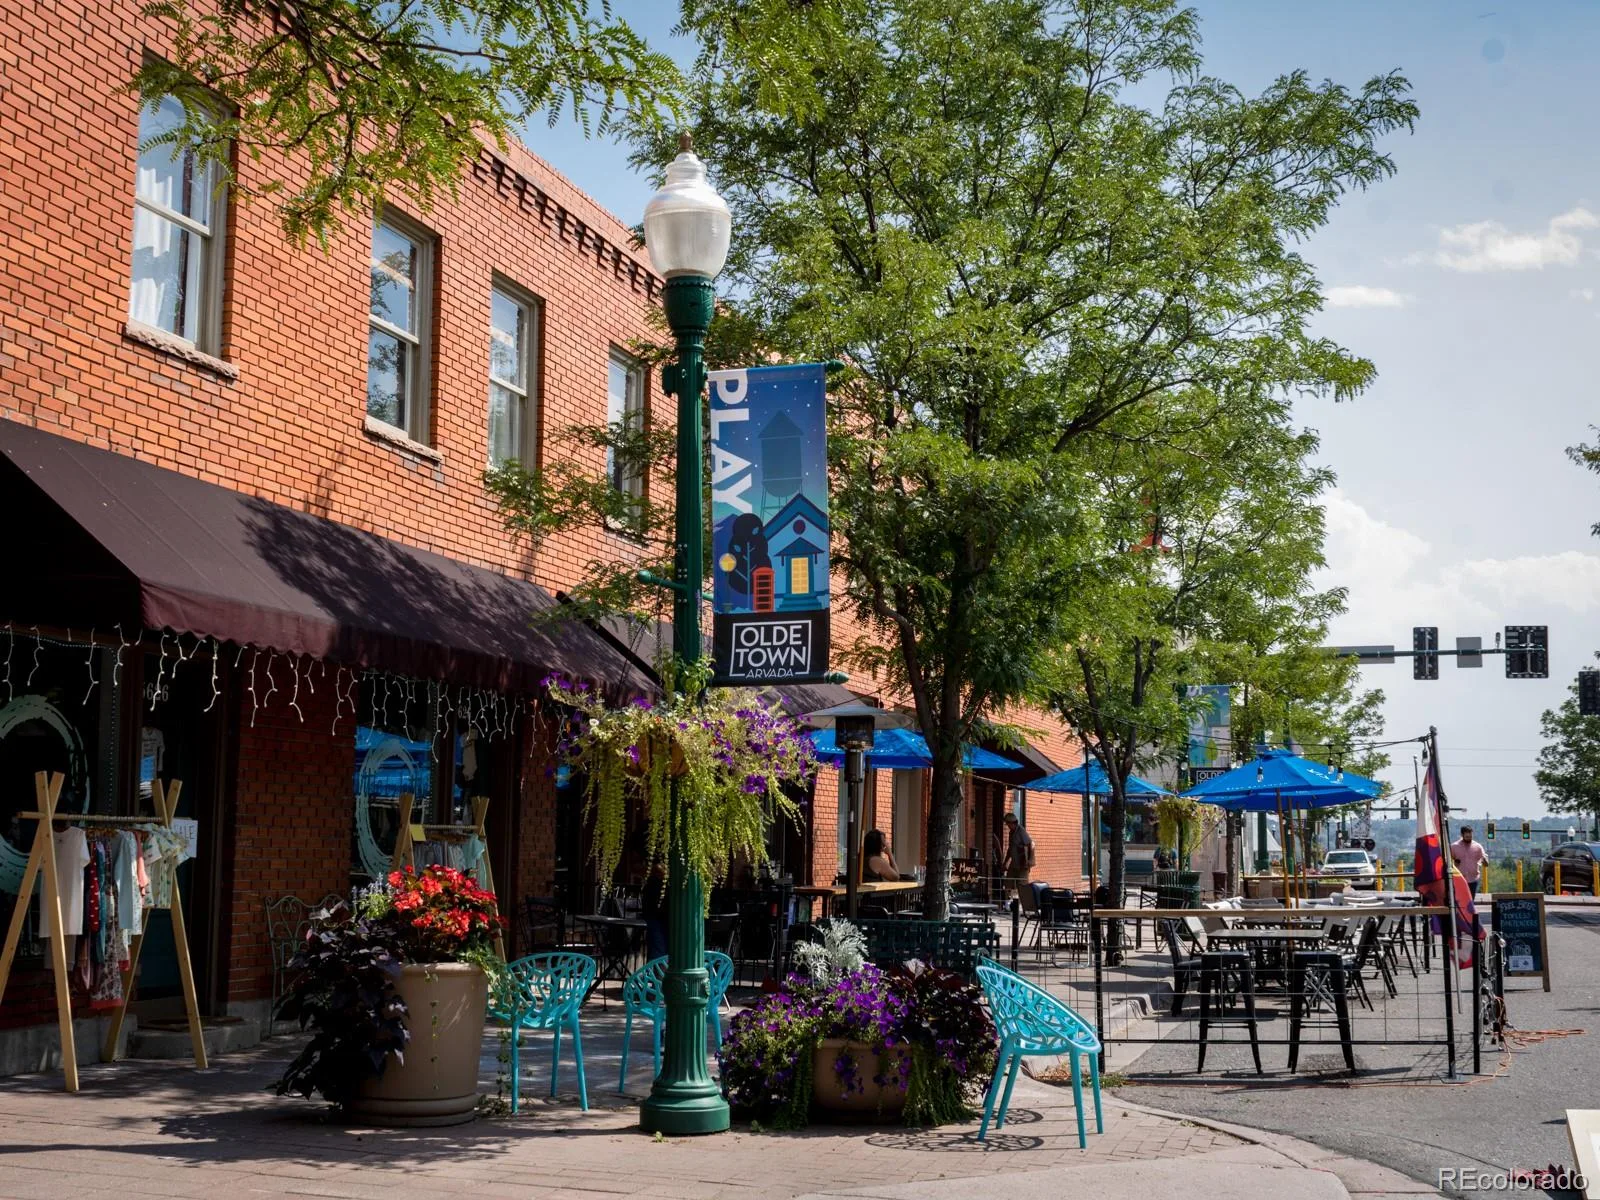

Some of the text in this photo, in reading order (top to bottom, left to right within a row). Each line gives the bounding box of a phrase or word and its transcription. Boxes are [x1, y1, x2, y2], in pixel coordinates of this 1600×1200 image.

[708, 368, 753, 514] PLAY
[740, 625, 802, 647] OLDE
[735, 646, 807, 669] TOWN
[745, 668, 794, 679] ARVADA
